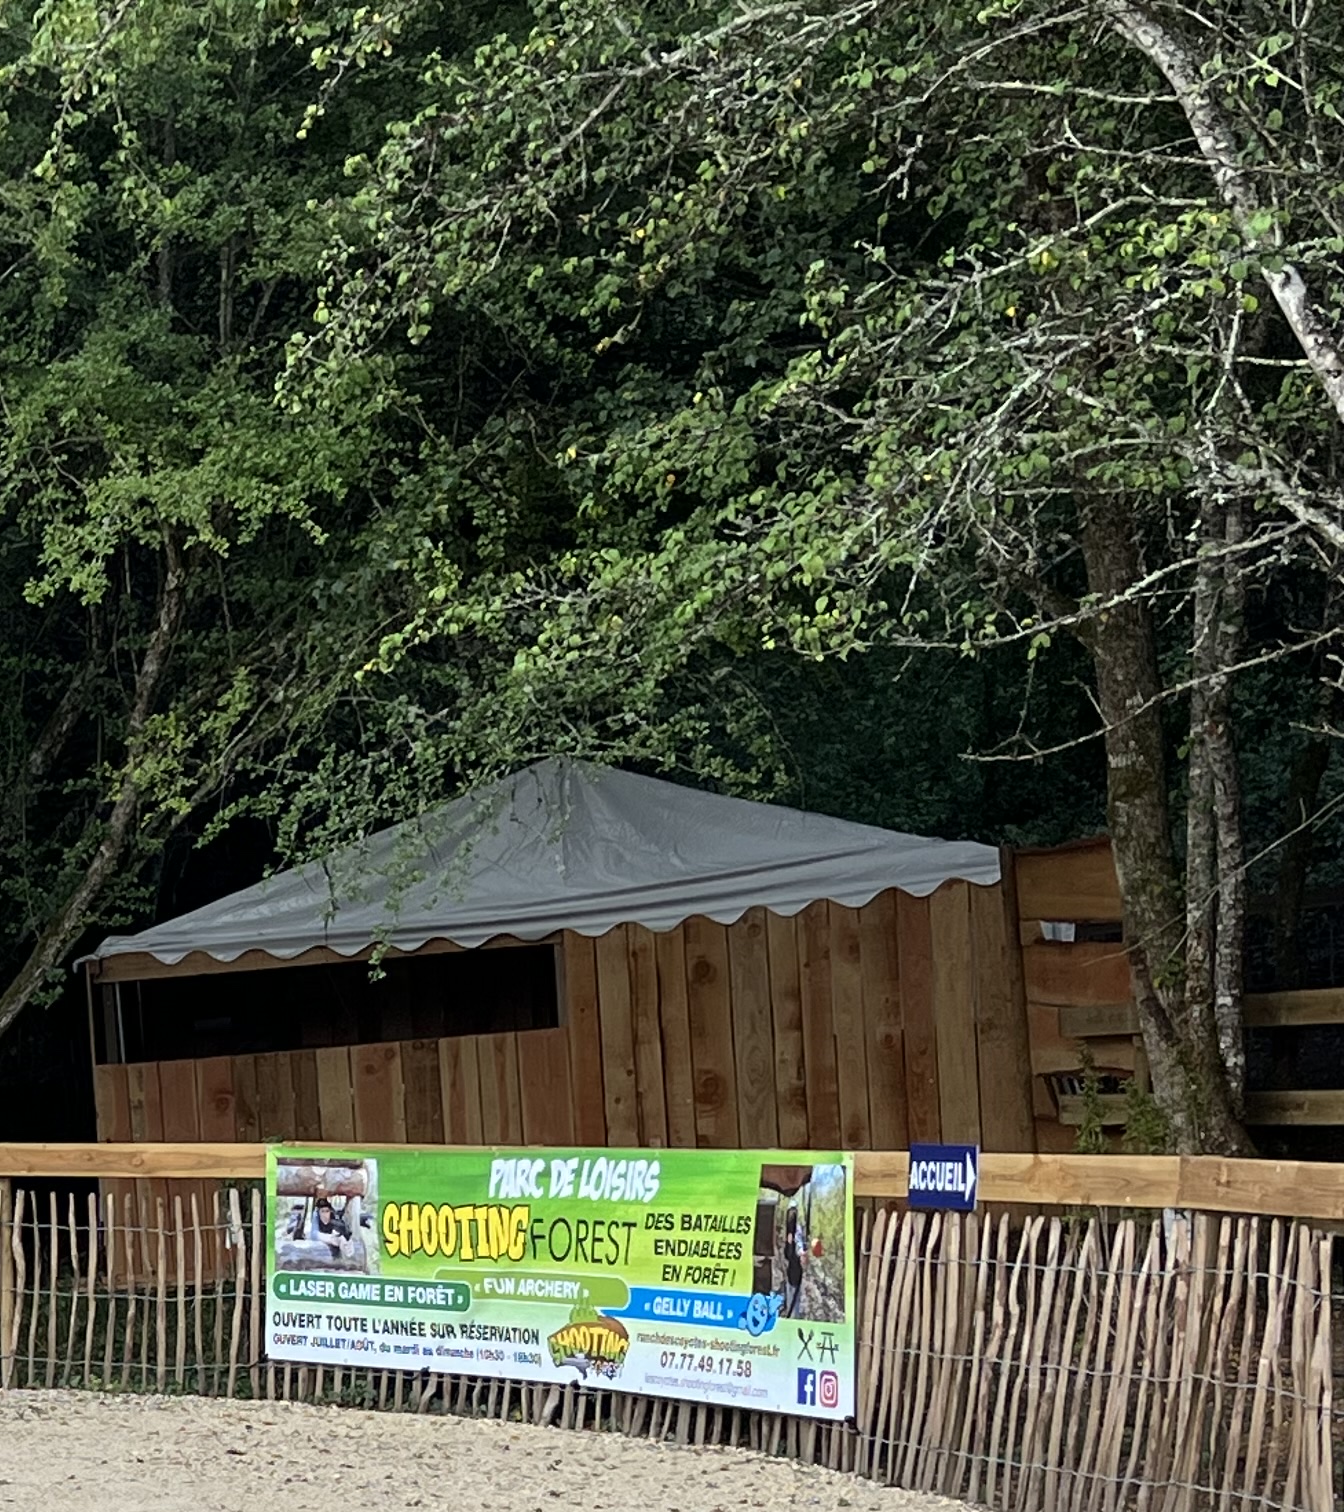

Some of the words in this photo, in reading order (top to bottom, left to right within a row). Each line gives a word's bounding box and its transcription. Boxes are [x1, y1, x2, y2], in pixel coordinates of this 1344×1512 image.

[488, 1157, 546, 1199] PARC
[549, 1158, 579, 1199] DE
[580, 1158, 661, 1204] LOISIRS
[909, 1160, 967, 1192] ACCUEIL
[644, 1213, 675, 1231] DES
[680, 1214, 752, 1234] BATAILLES
[653, 1238, 743, 1260] ENDIABLÉES
[661, 1263, 682, 1281] EN
[683, 1263, 728, 1285] FORÊT
[730, 1270, 737, 1286] !
[289, 1278, 336, 1299] LASER
[338, 1281, 382, 1301] GAME
[384, 1284, 404, 1302] EN
[407, 1281, 455, 1305] FORÊT
[483, 1277, 515, 1294] FUN
[517, 1280, 581, 1300] ARCHERY
[652, 1296, 691, 1317] GELLY
[693, 1299, 724, 1321] BALL
[272, 1311, 322, 1330] OUVERT
[326, 1314, 368, 1332] TOUTE
[372, 1316, 427, 1338] L'ANNÉE
[430, 1322, 457, 1339] SUR
[459, 1319, 540, 1345] RÉSERVATION
[273, 1332, 309, 1346] OUVERT
[379, 1341, 391, 1353] du
[393, 1343, 420, 1355] mardi
[436, 1345, 474, 1359] dimanche
[548, 1326, 629, 1368] SHOOTING
[660, 1350, 752, 1378] 07.77.49.17.58
